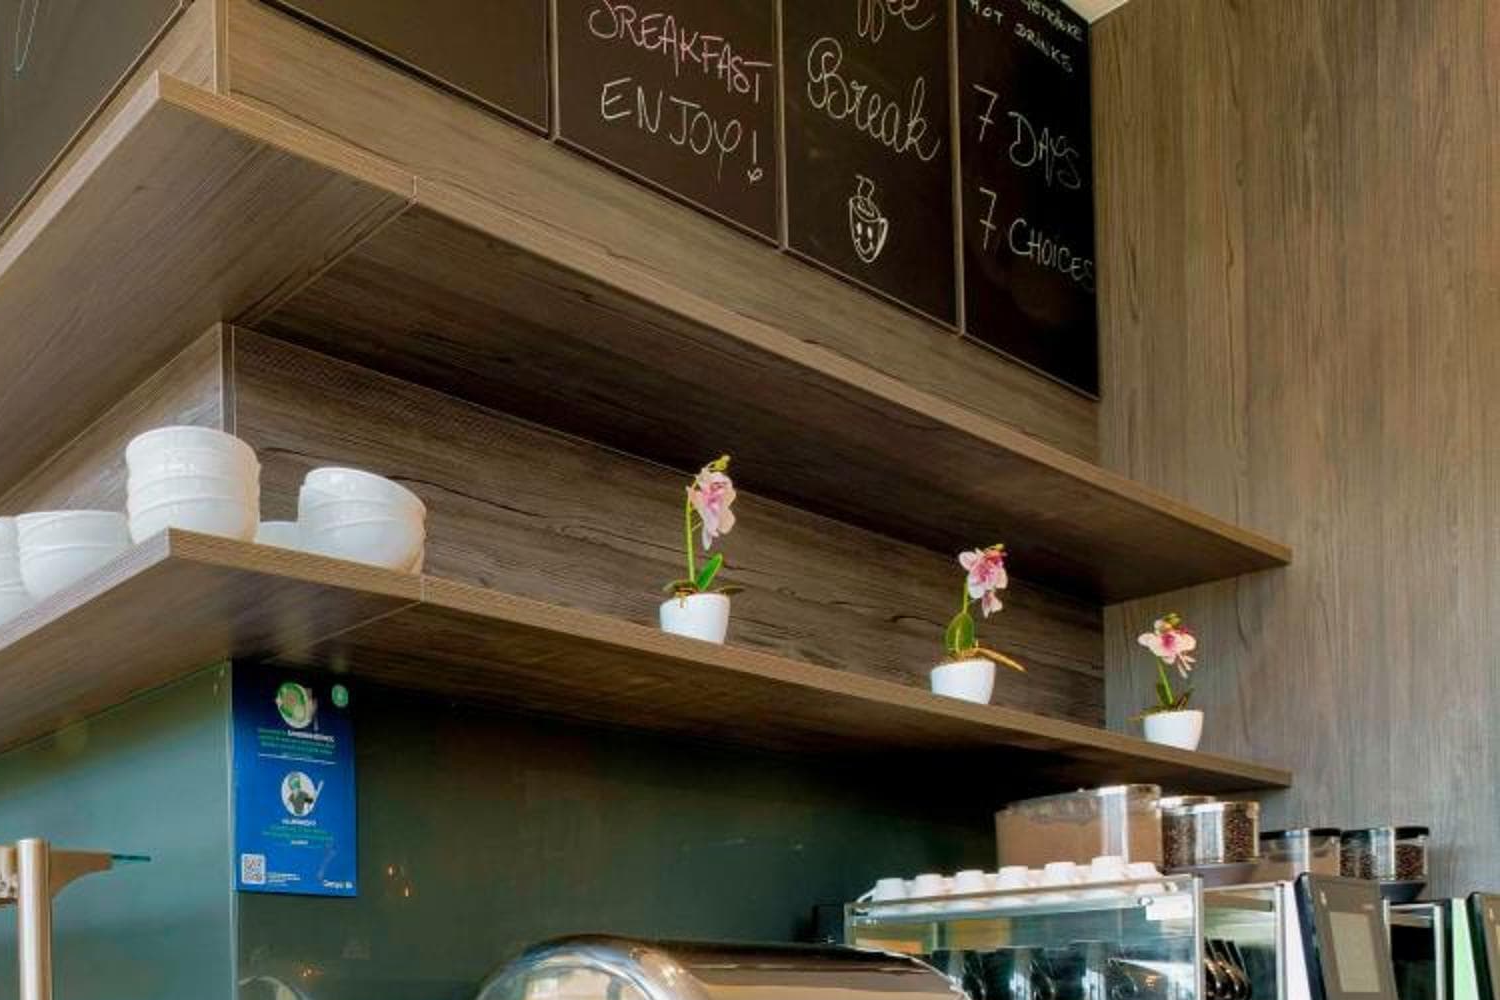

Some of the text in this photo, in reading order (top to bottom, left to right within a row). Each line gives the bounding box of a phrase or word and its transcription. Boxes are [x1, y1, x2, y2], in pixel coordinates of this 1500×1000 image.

[808, 37, 940, 160] Break
[973, 83, 1081, 189] 7 DAYS
[979, 187, 997, 250] 7
